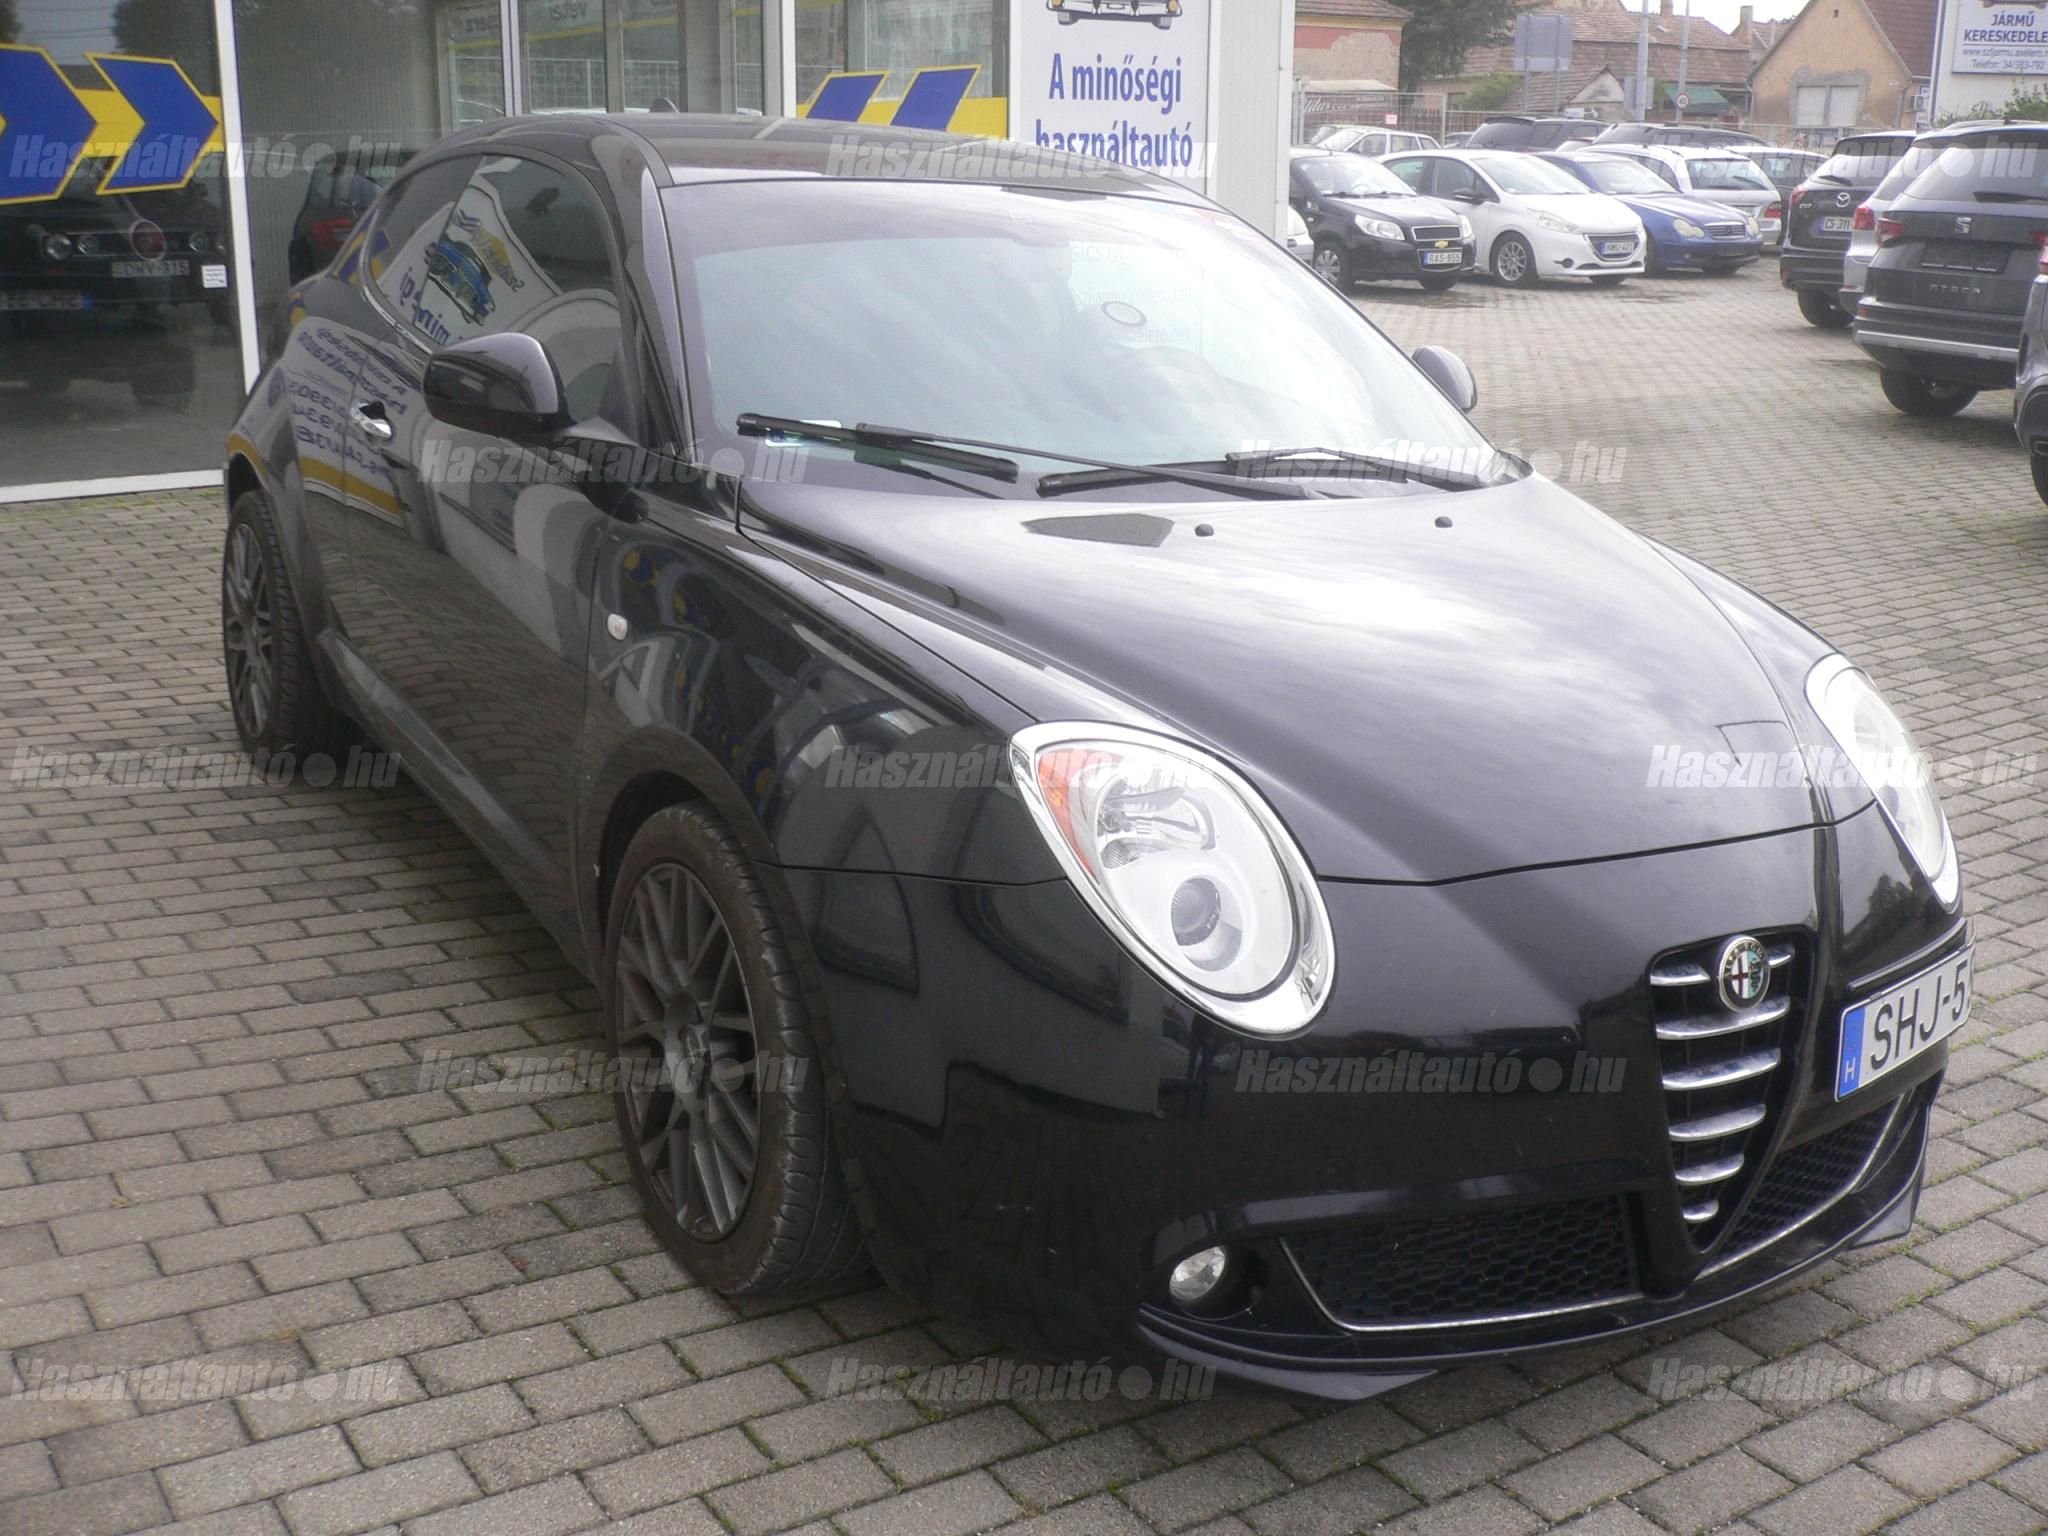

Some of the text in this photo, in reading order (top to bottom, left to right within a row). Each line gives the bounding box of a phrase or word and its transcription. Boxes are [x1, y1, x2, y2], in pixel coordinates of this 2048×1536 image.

[1991, 10, 2035, 27] JÁRMŰ
[1049, 53, 1181, 114] A minőségi
[1871, 959, 1968, 1070] SHJ-5
